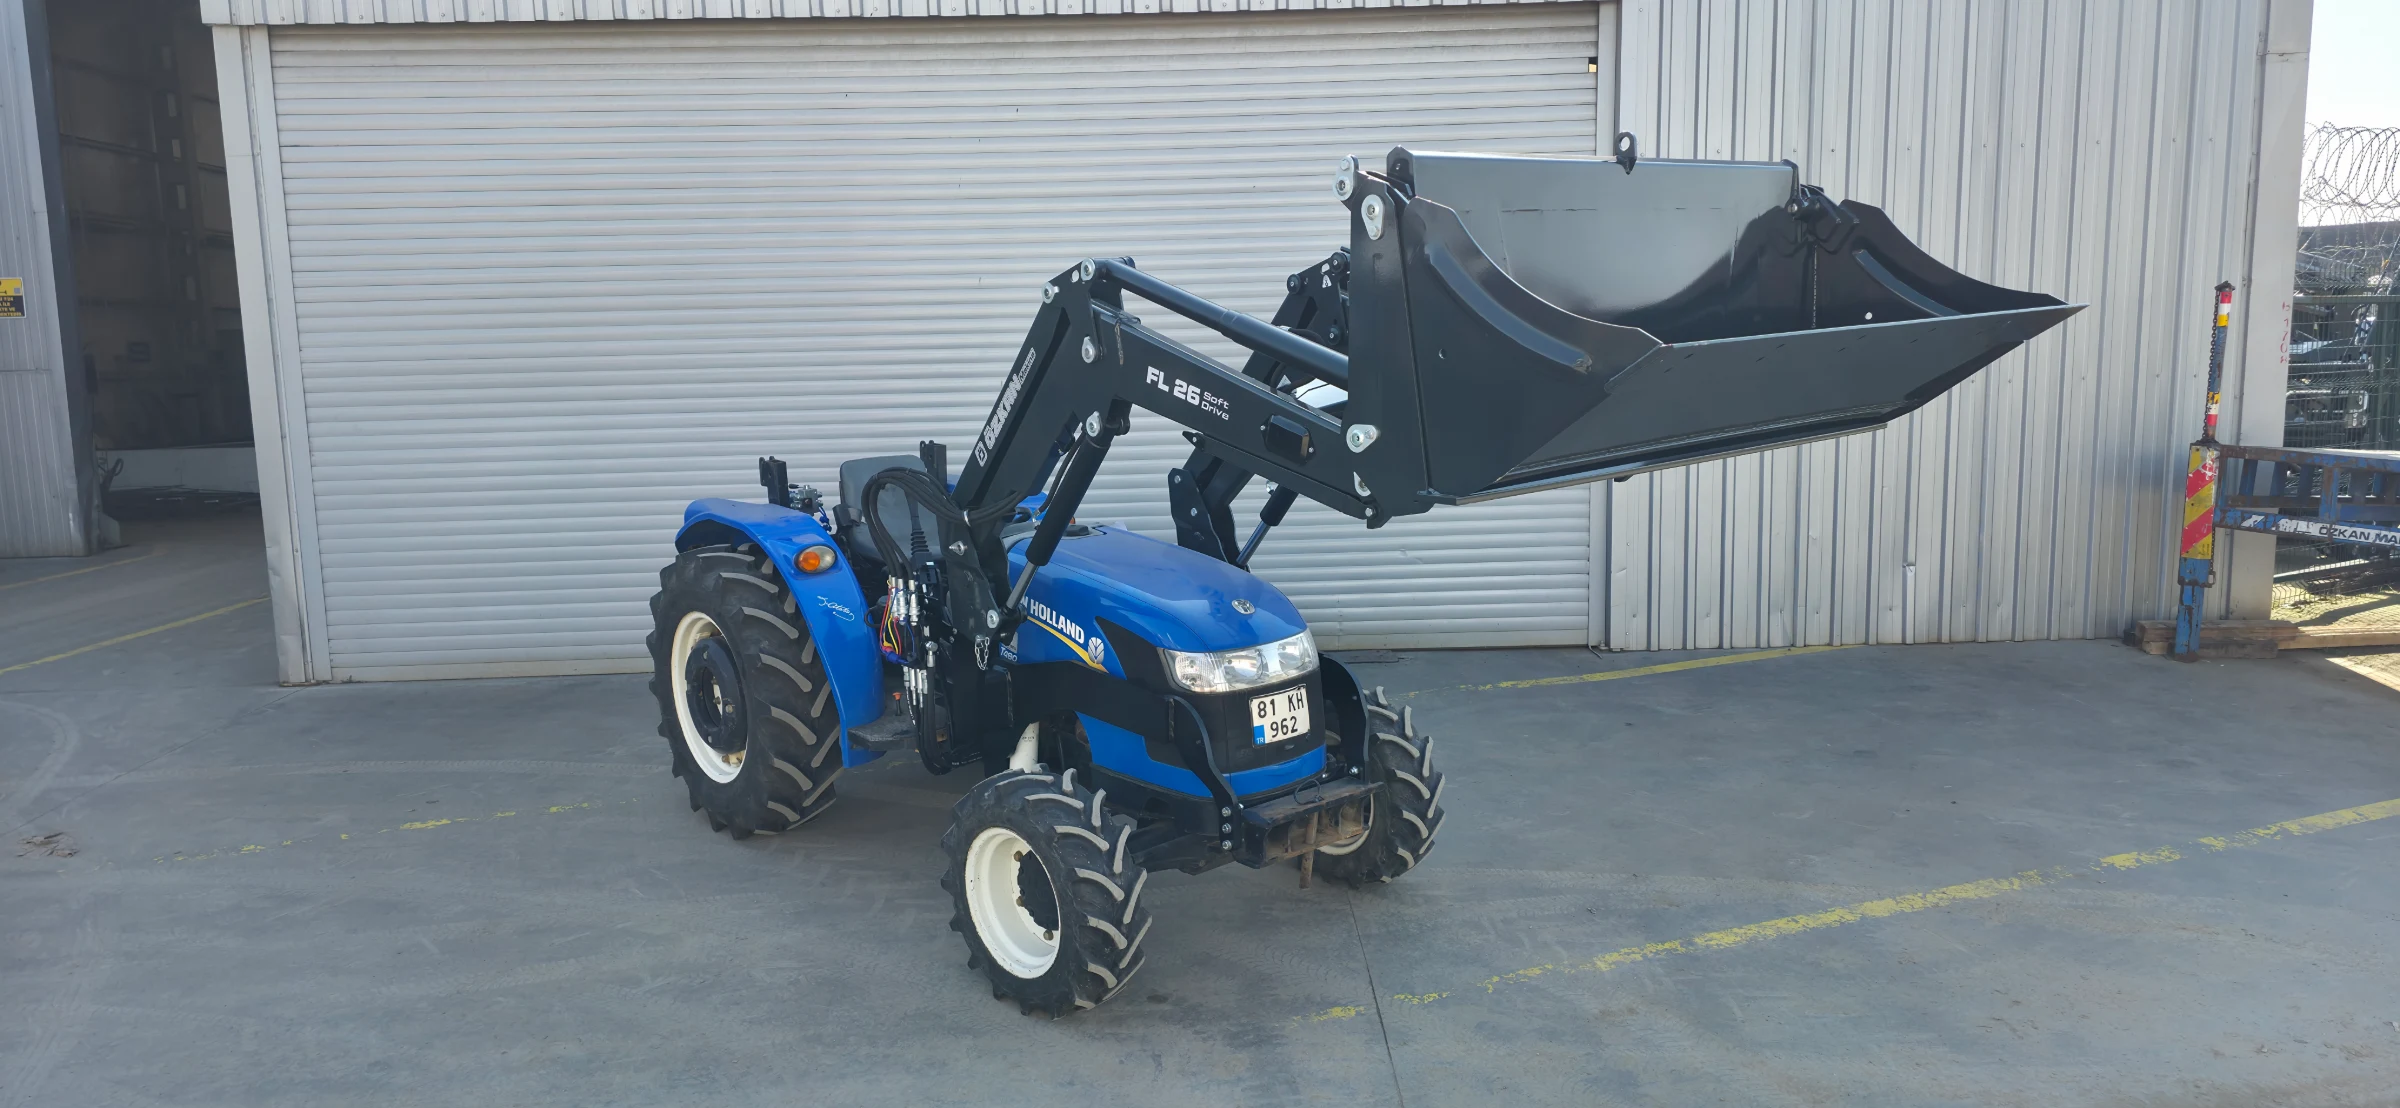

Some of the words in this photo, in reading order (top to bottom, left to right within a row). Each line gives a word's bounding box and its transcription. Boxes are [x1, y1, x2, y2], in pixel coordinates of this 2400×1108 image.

[1146, 365, 1170, 393] FL
[1173, 378, 1201, 406] 26
[1201, 400, 1230, 421] Drive
[1203, 391, 1230, 410] Soft
[2318, 524, 2370, 541] ÖZKAN
[2374, 532, 2400, 544] MA
[1030, 598, 1085, 645] HOLLAND
[1257, 698, 1276, 719] 81
[1287, 691, 1304, 713] KH
[1270, 715, 1298, 738] 962
[1256, 737, 1264, 745] TR
